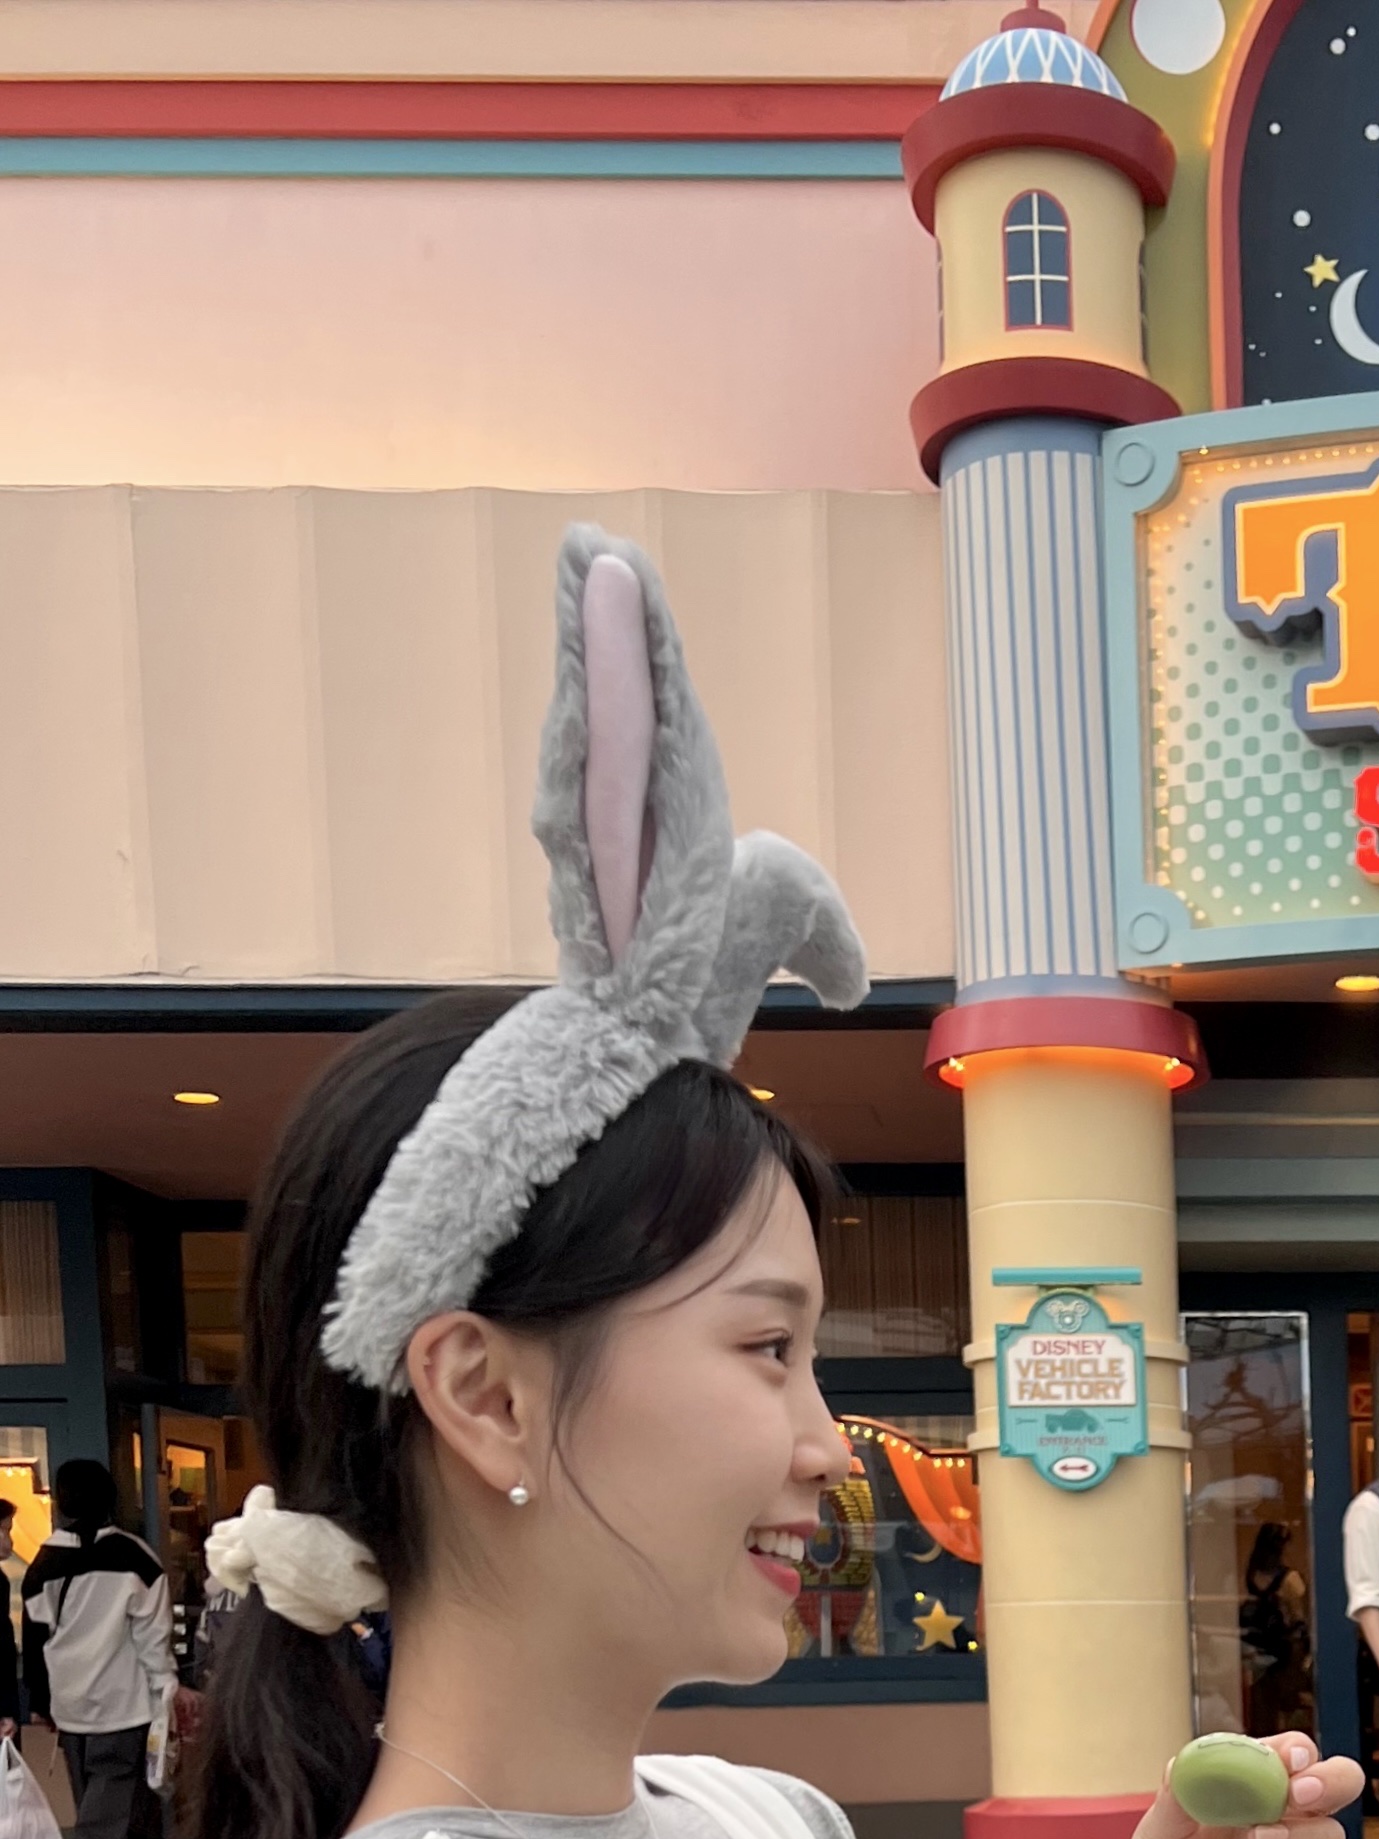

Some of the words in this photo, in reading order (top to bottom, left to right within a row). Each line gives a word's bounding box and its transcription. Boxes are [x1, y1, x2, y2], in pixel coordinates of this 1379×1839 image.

[1033, 1340, 1106, 1355] DISNEY
[1017, 1359, 1124, 1378] VEHICLE
[1019, 1381, 1125, 1400] FACTORY
